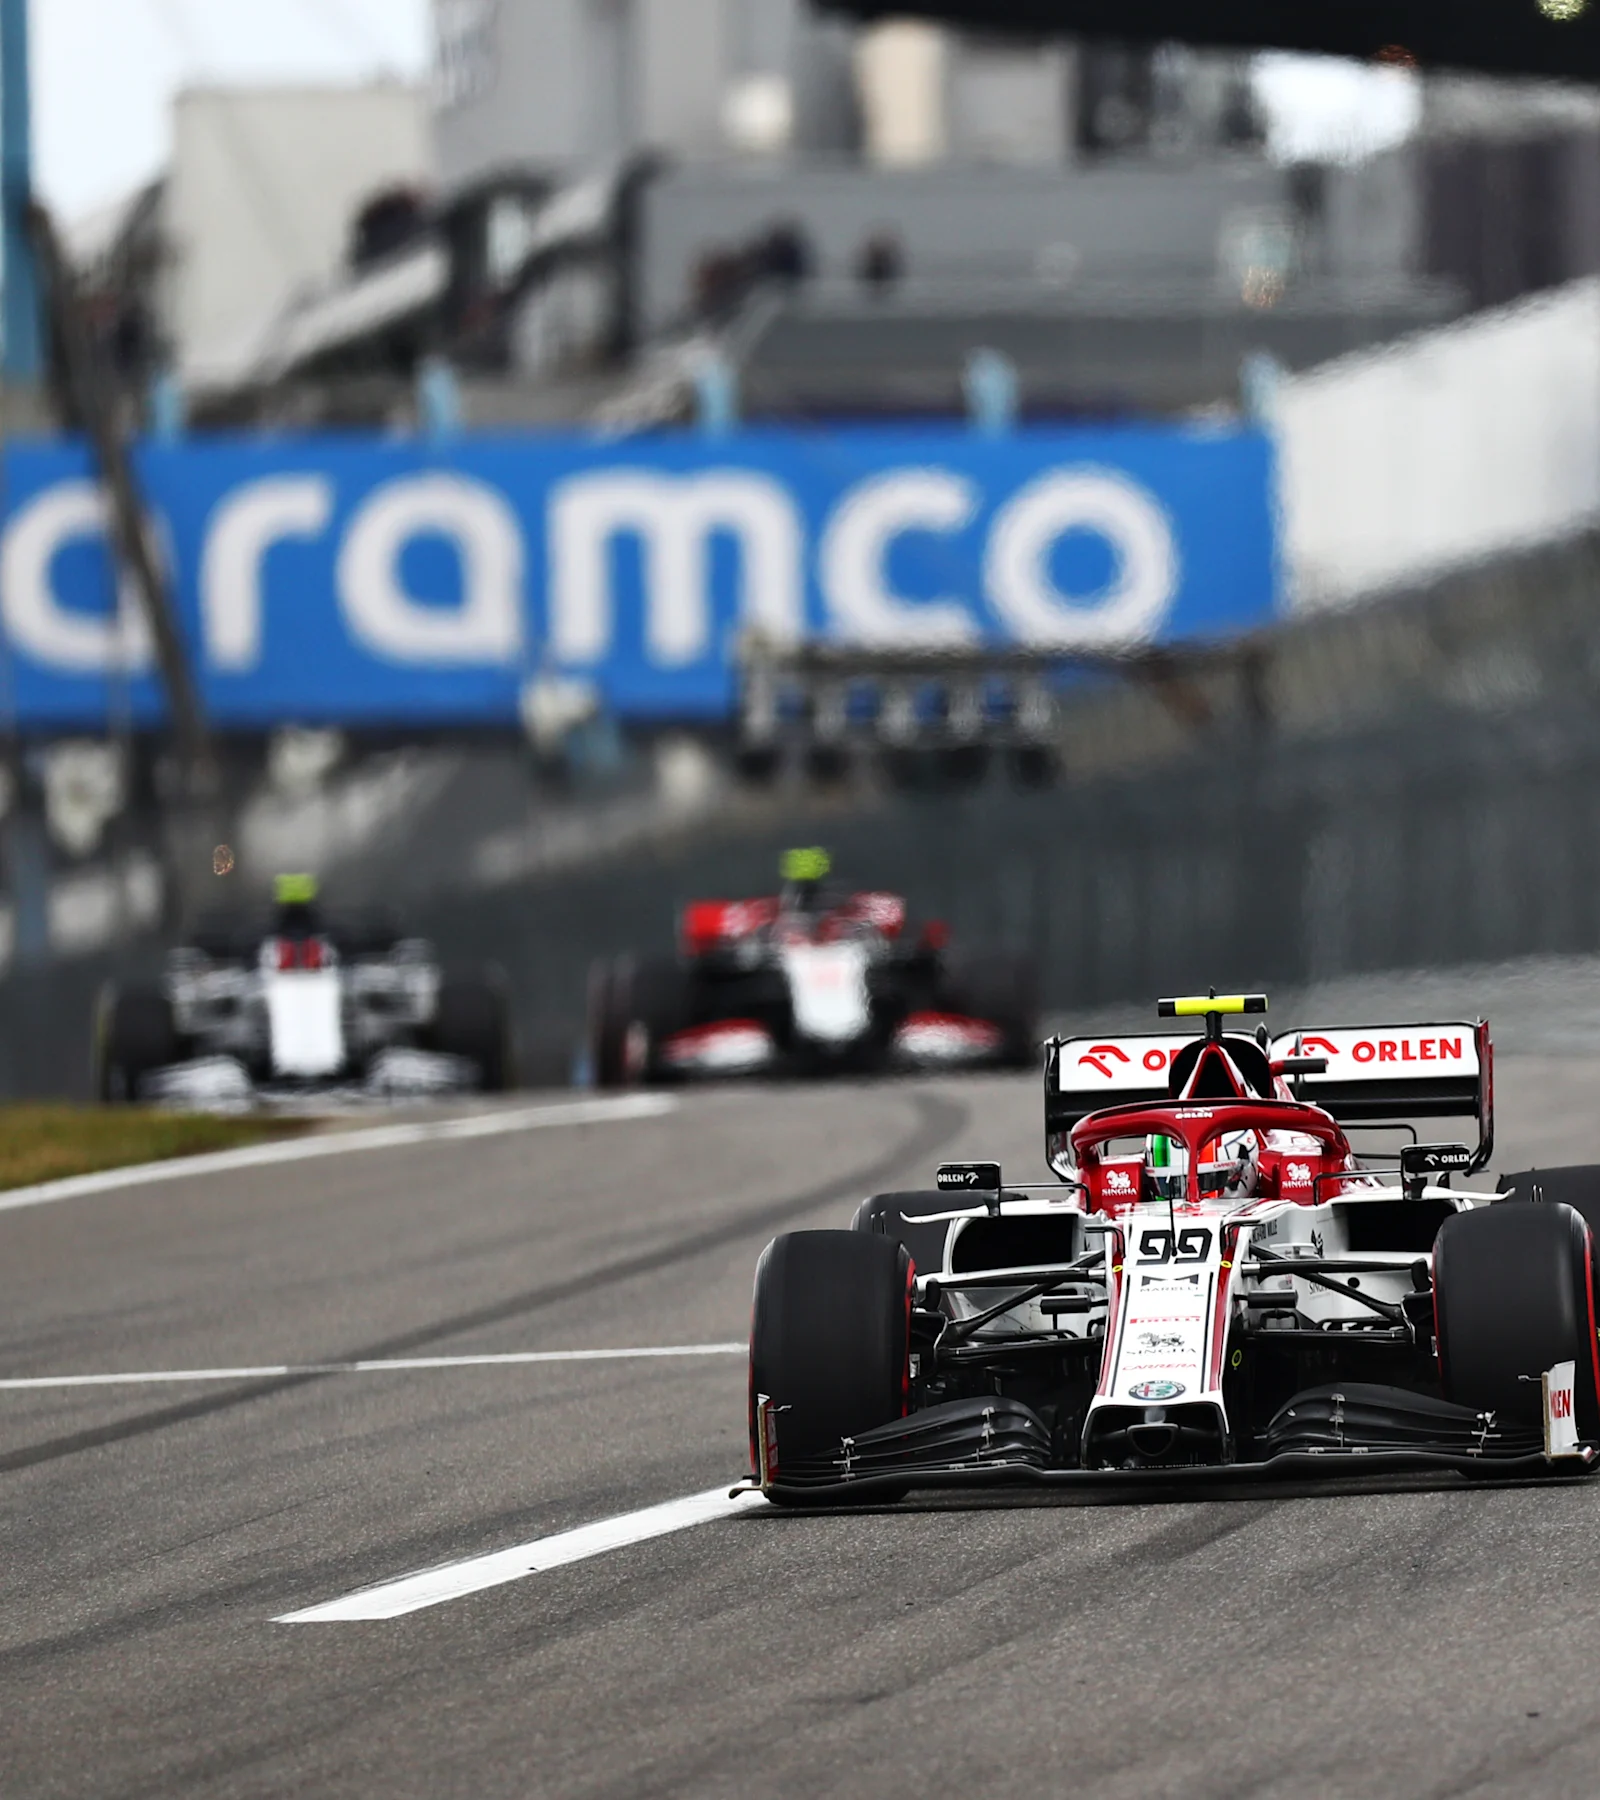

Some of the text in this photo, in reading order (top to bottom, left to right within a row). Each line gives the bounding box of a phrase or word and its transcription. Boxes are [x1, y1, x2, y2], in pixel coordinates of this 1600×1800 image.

[0, 466, 1181, 674] aramco
[1352, 1038, 1462, 1063] ORLEN
[1175, 1111, 1213, 1120] ORLEN
[1441, 1154, 1470, 1163] ORLEN
[937, 1173, 965, 1183] ORLEN
[1101, 1187, 1137, 1196] SINGHA
[1136, 1228, 1213, 1266] 99
[1122, 1363, 1197, 1371] CARRERA
